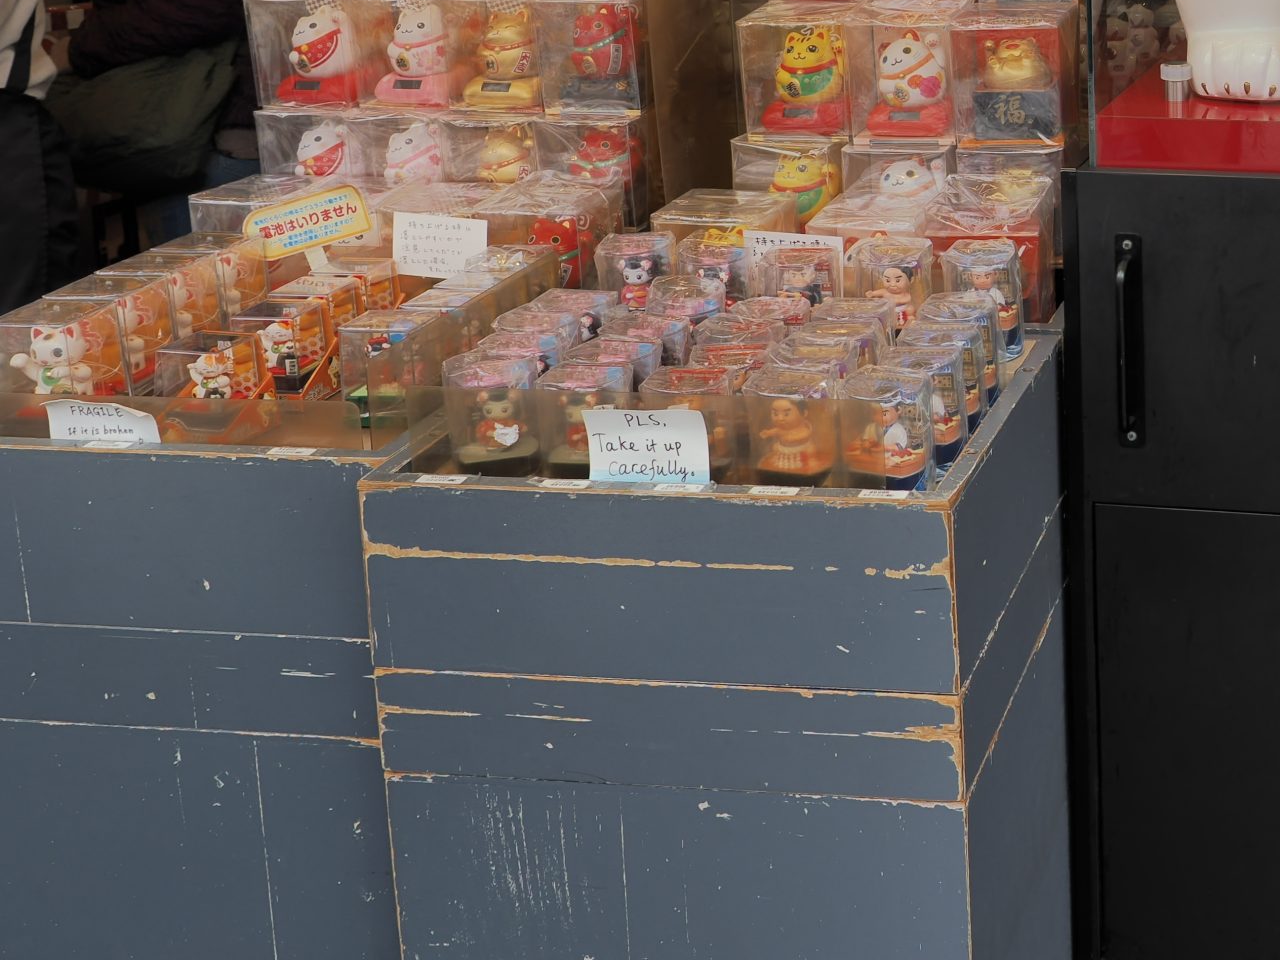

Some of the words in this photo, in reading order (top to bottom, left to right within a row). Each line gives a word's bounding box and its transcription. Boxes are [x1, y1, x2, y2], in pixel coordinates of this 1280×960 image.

[995, 94, 1026, 124] 福
[260, 203, 357, 239] 電池はいりません
[70, 405, 124, 418] FRAGILE
[103, 426, 134, 436] broken
[592, 433, 638, 453] Take
[644, 438, 657, 453] it
[663, 440, 682, 456] up
